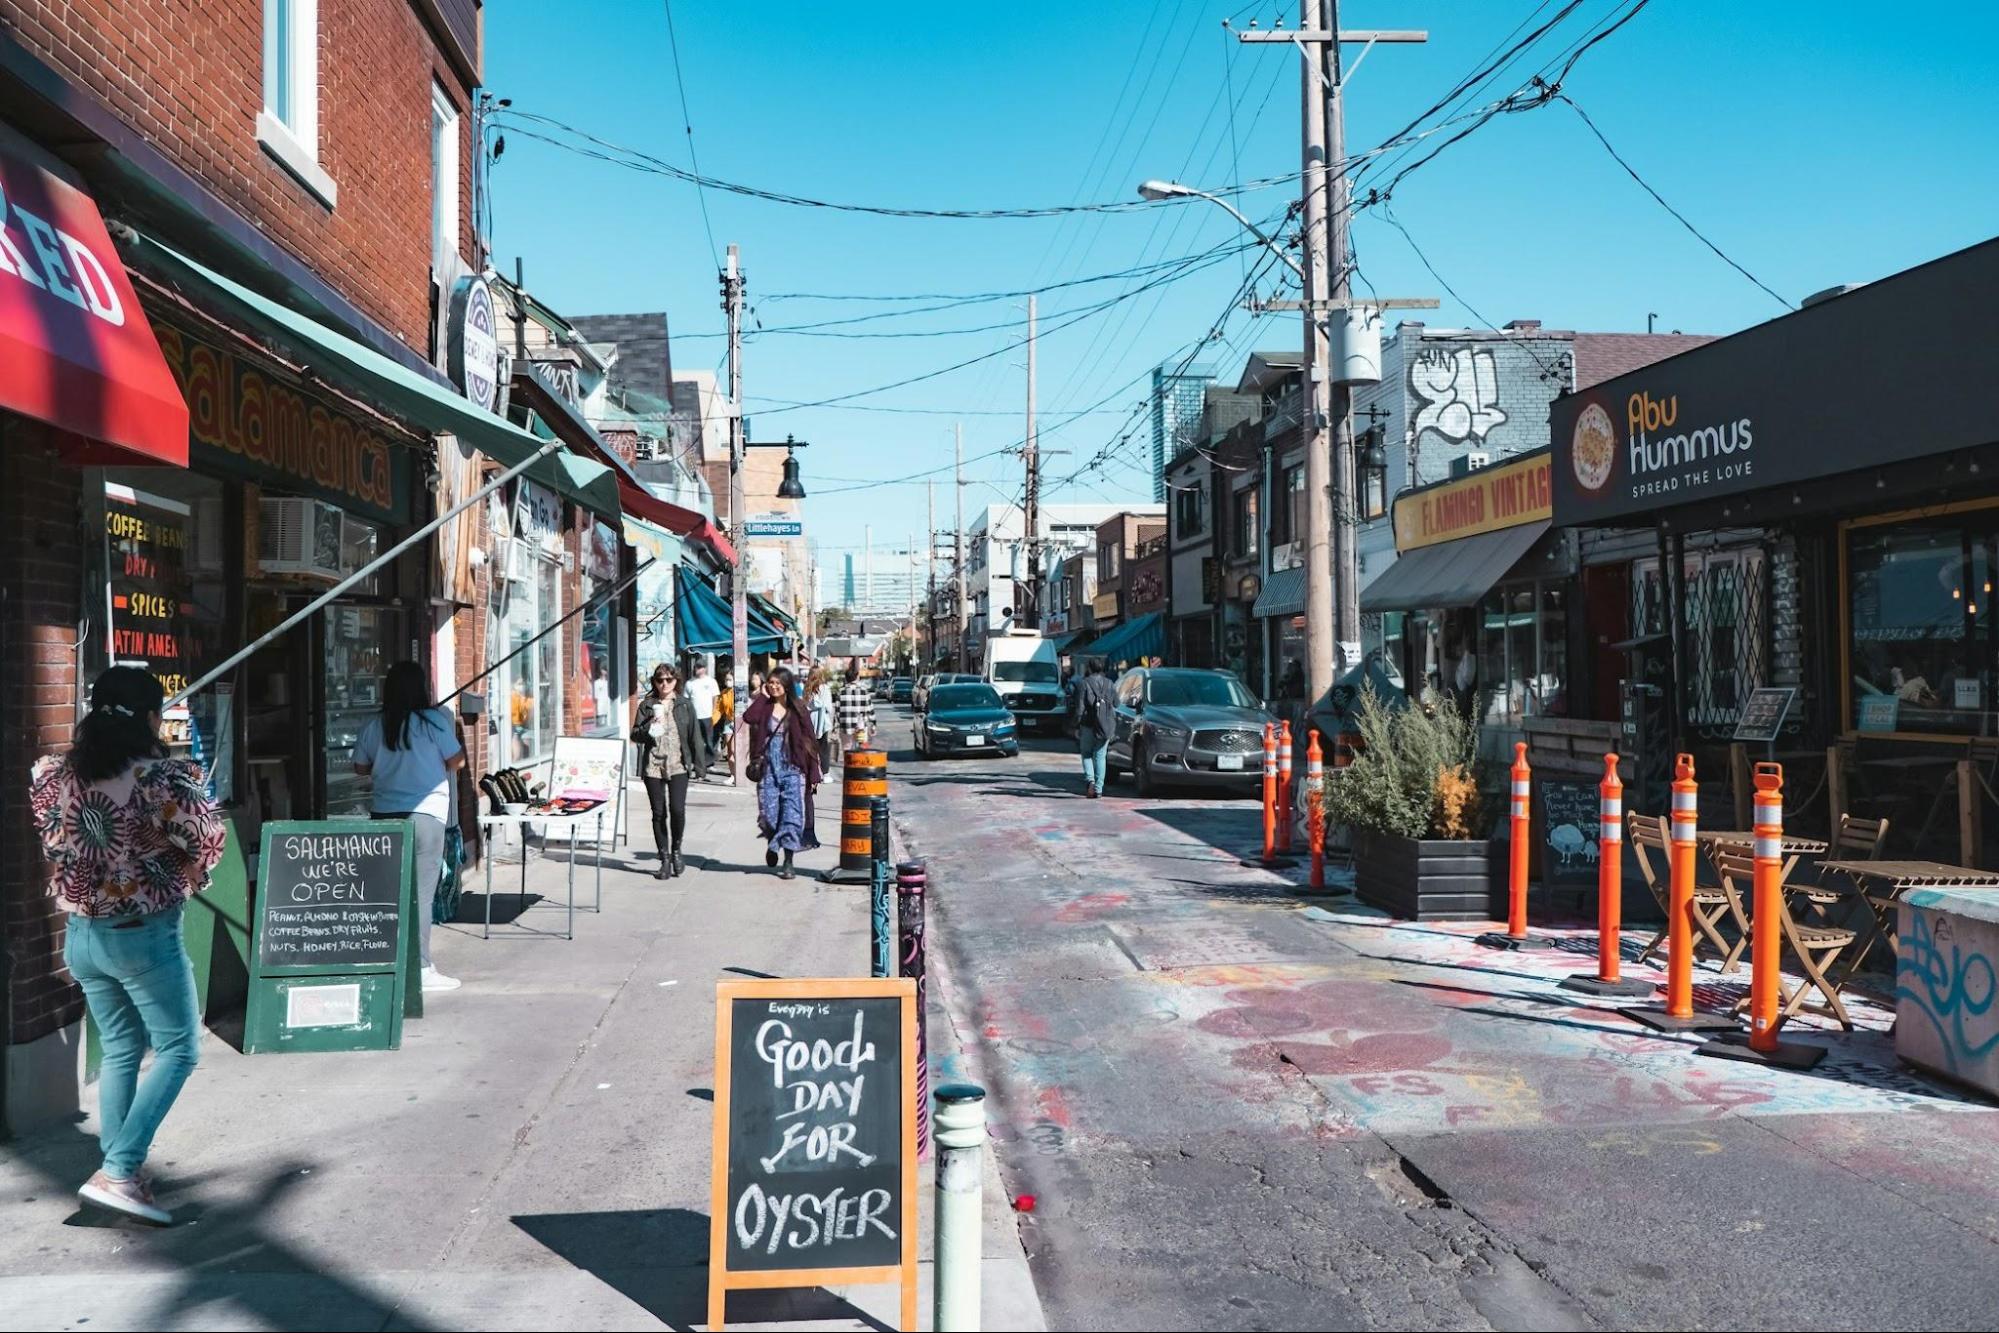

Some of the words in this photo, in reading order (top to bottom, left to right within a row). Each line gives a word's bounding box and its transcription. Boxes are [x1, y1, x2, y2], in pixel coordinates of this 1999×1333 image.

[1628, 390, 1677, 437] Abu
[1629, 418, 1753, 475] Hummus
[1632, 477, 1679, 498] SPREAD
[1685, 470, 1710, 487] THE
[1717, 461, 1752, 481] LOVE
[1422, 484, 1485, 537] FLAMINGO
[106, 512, 150, 541] COFFEE
[747, 524, 791, 535] Littlehayes
[125, 554, 147, 578] DRY
[131, 592, 175, 618] SPICES
[285, 835, 392, 860] SALAMANCA
[302, 861, 359, 879] WE'RE
[291, 881, 365, 901] OPEN
[331, 924, 350, 936] DRY
[817, 1002, 830, 1015] is
[755, 1009, 875, 1088] Good
[775, 1074, 865, 1120] DAY
[760, 1122, 878, 1174] FOR
[735, 1183, 898, 1254] OYSTER
